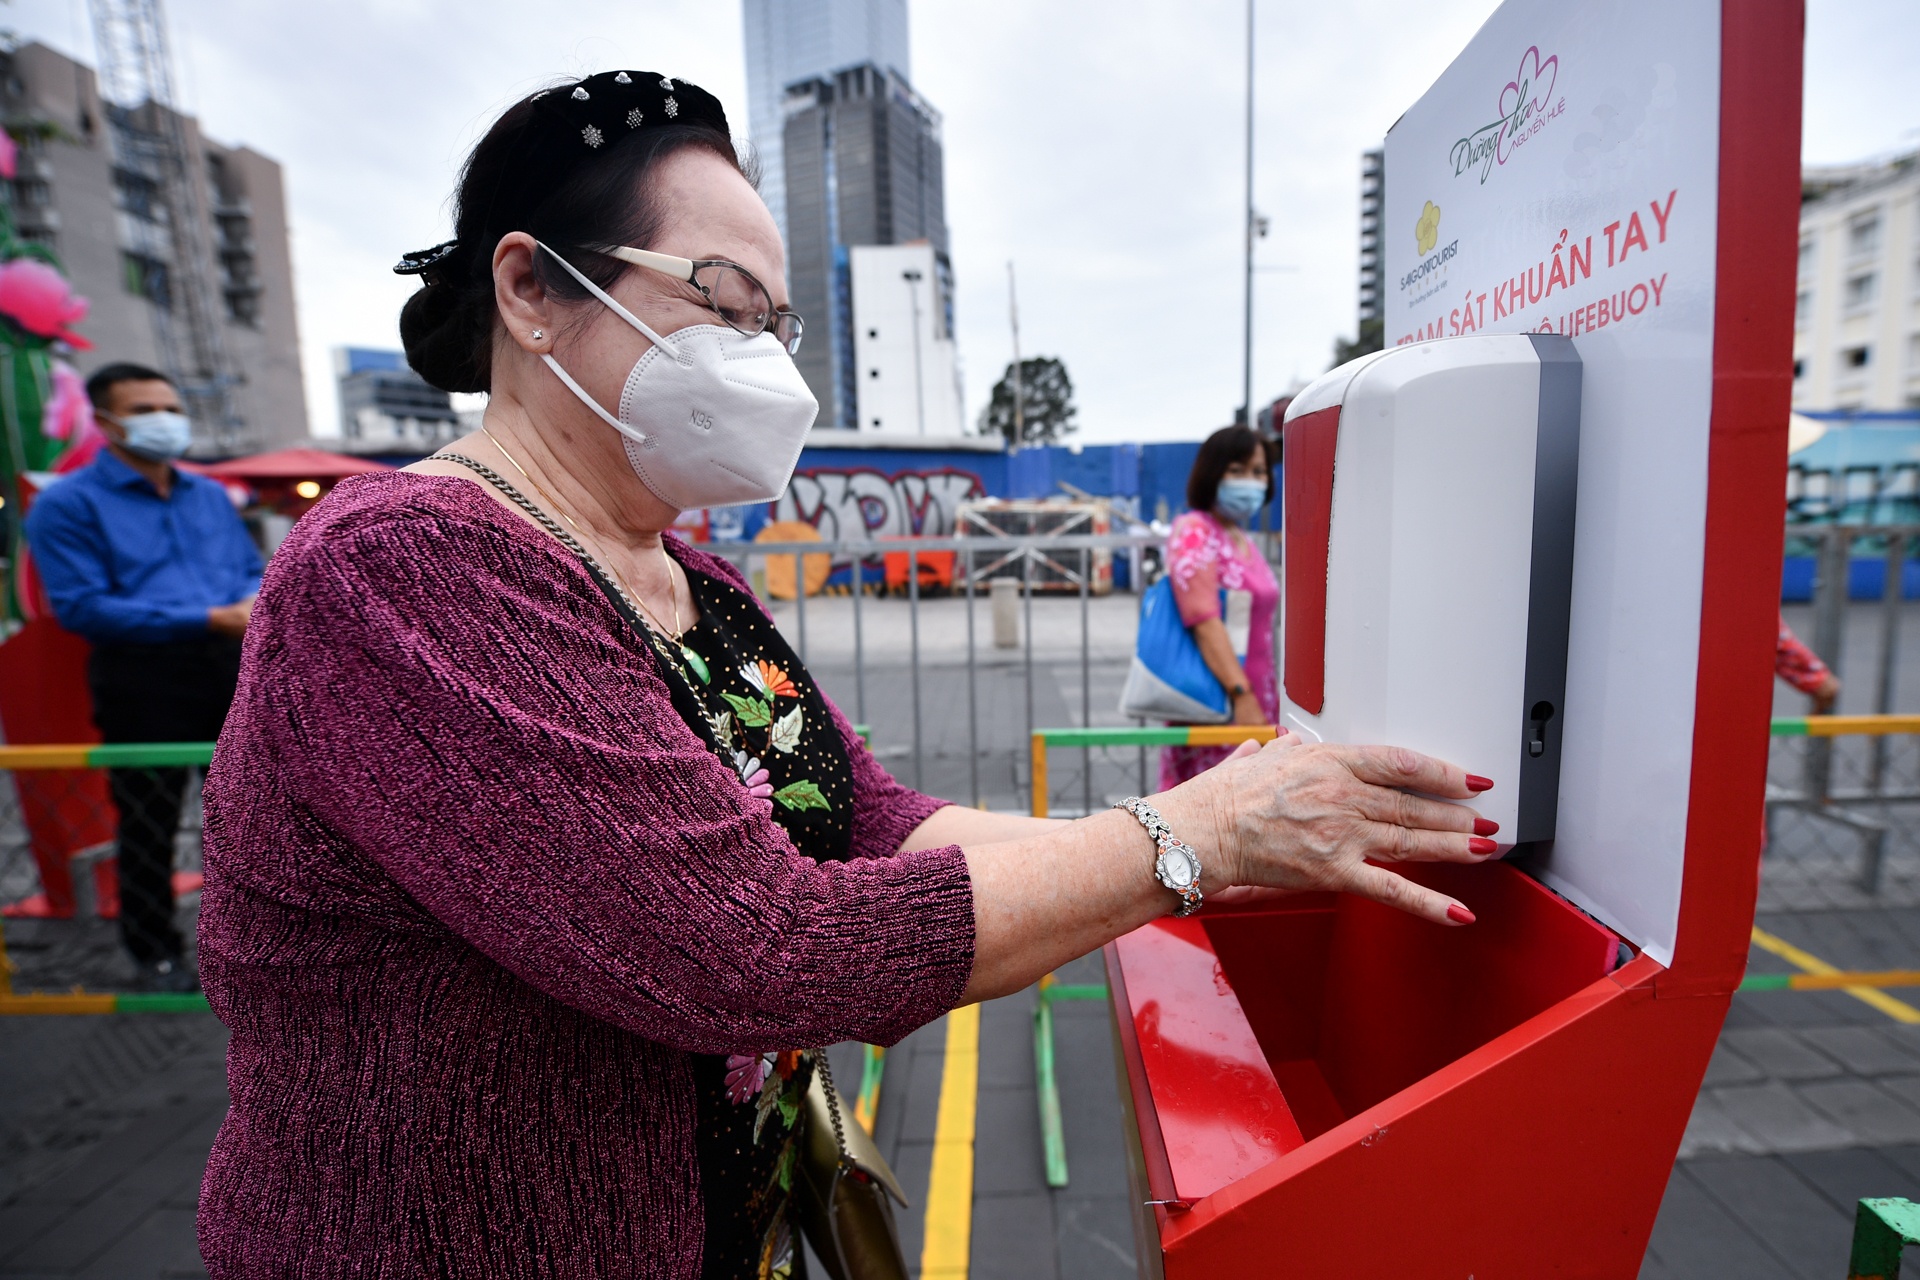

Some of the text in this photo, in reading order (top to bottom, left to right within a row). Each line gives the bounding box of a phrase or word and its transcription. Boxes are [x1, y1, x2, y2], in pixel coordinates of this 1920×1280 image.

[1400, 239, 1459, 291] SAIGONTOURIST
[1449, 189, 1678, 336] SÁT KHUẨN TAY
[689, 409, 714, 431] N95
